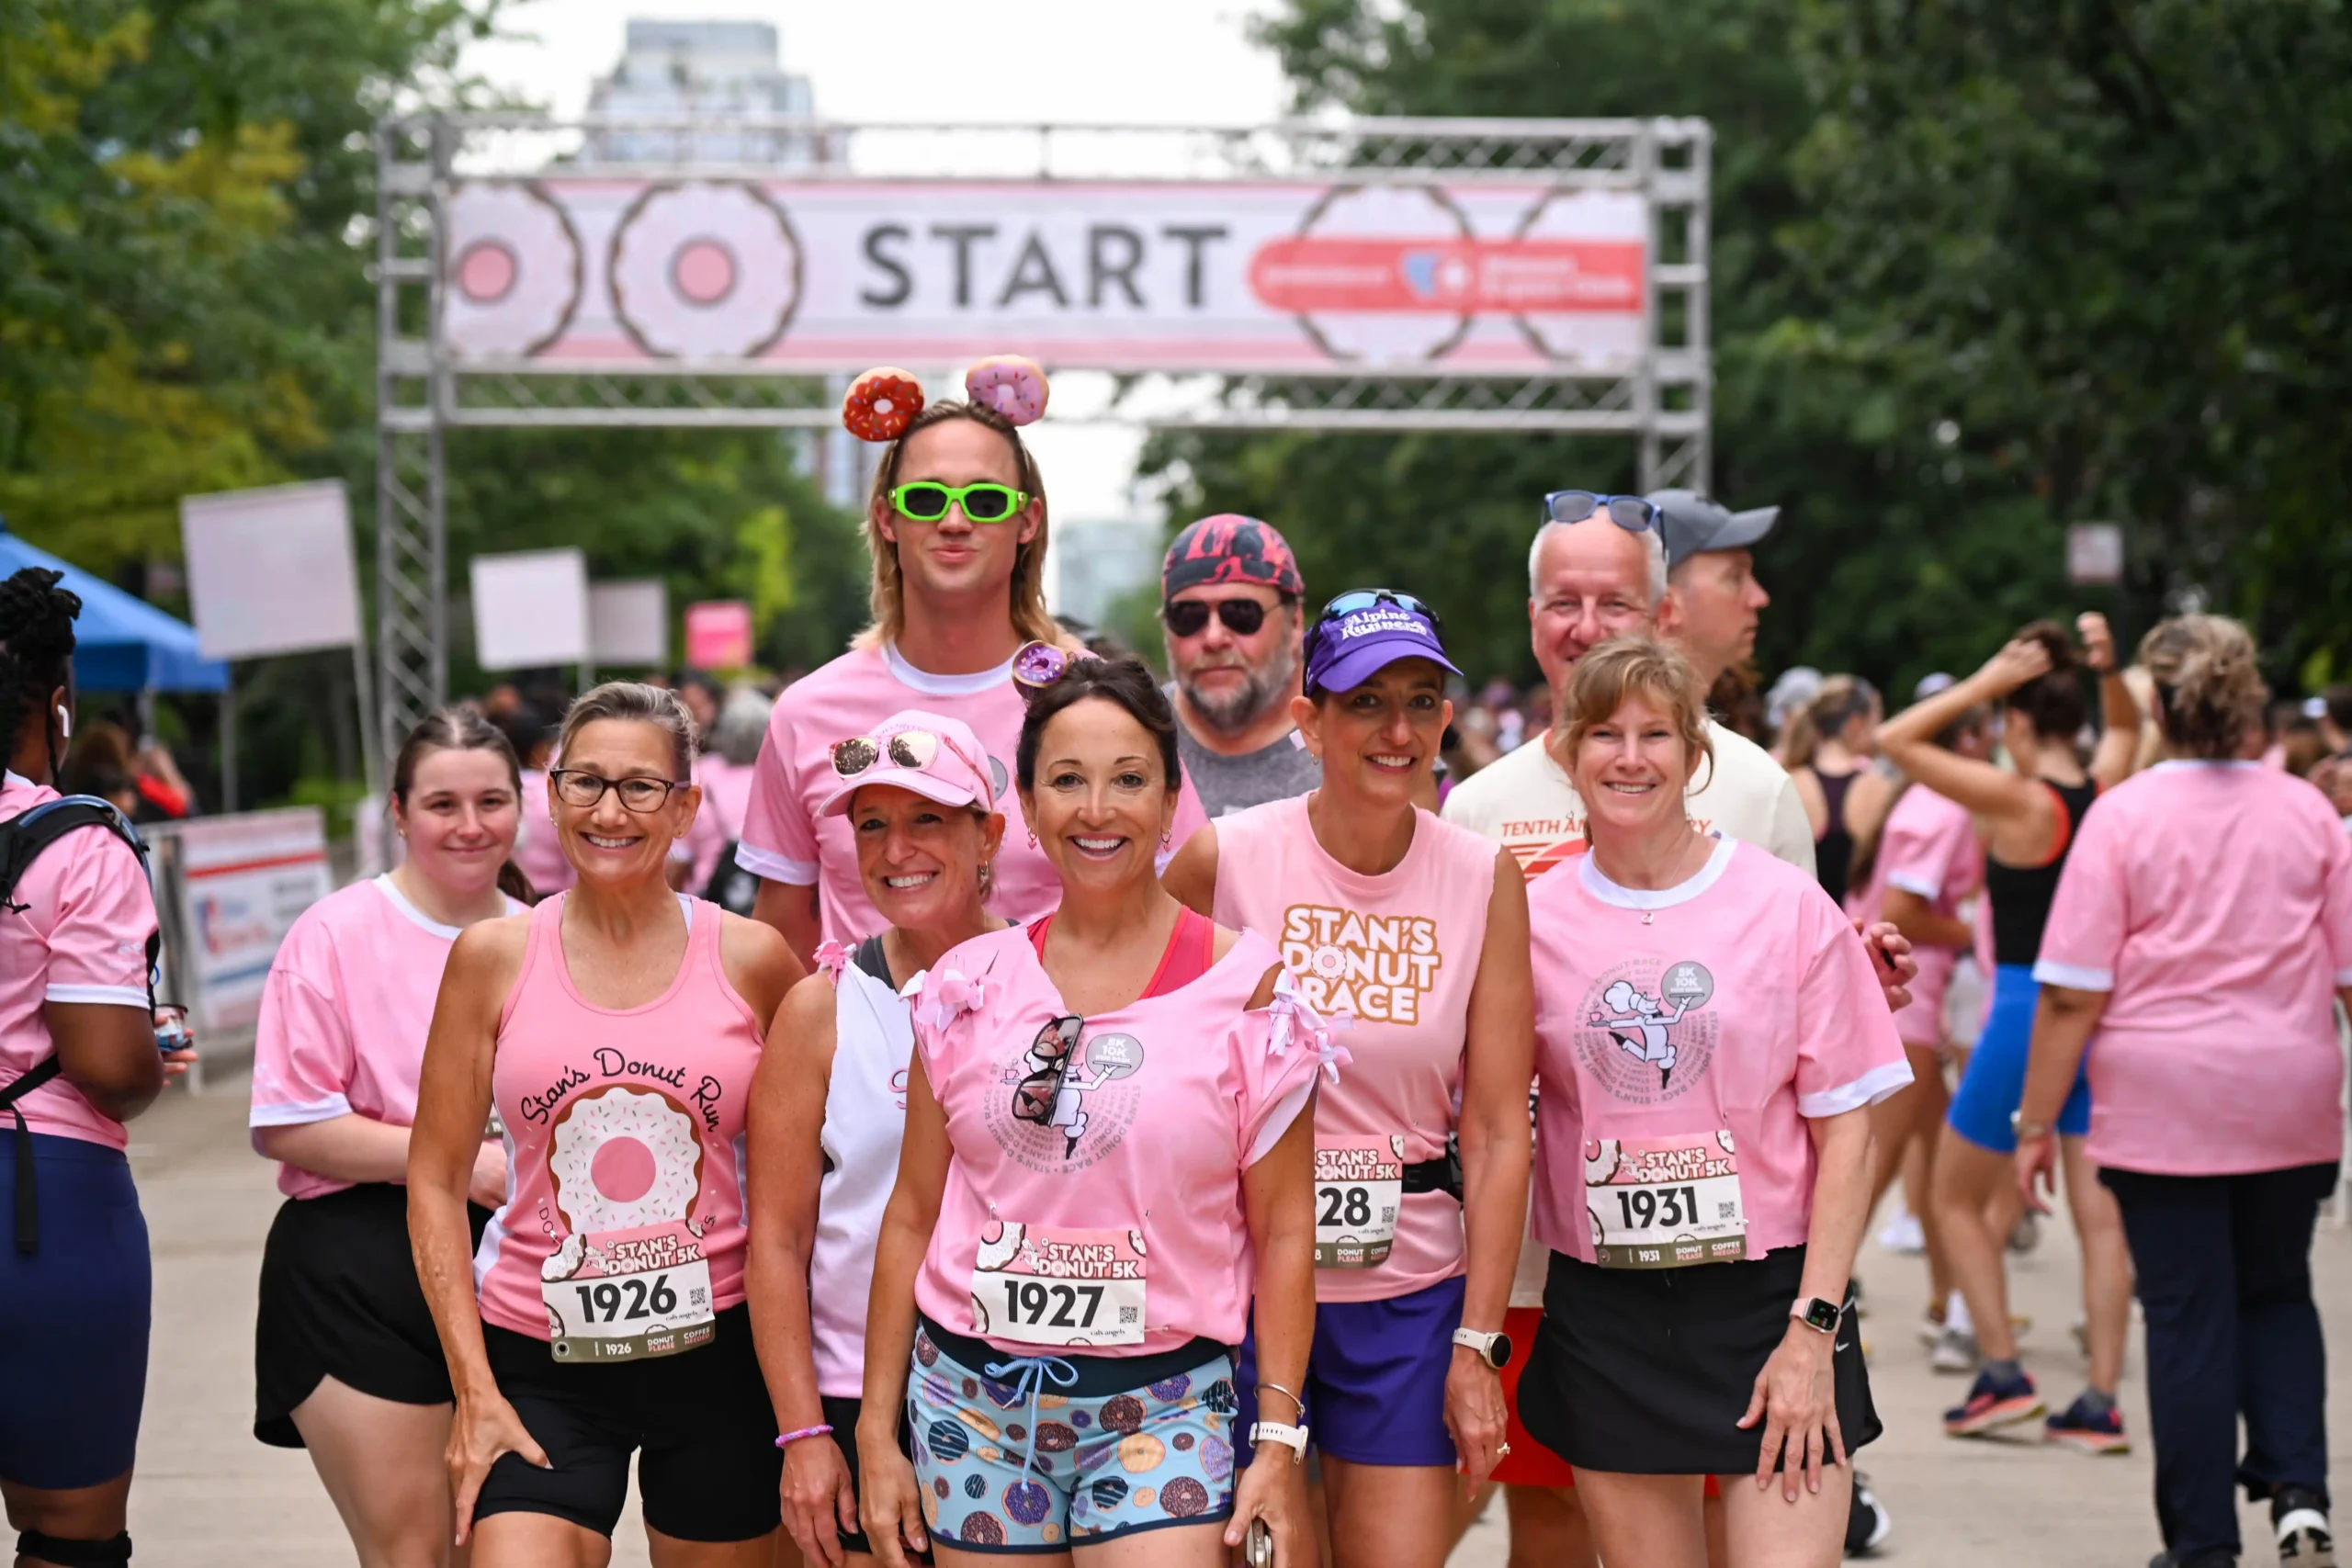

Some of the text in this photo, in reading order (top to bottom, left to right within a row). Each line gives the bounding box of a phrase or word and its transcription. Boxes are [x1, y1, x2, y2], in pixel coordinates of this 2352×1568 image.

[858, 223, 1229, 308] START
[1344, 608, 1411, 624] Alpine
[1340, 619, 1427, 640] Runners
[1501, 819, 1561, 838] TENTH
[1284, 905, 1435, 953] STAN'S
[1281, 940, 1440, 988] DONUT
[1678, 966, 1695, 977] 5K
[1675, 976, 1699, 987] 10K
[1301, 976, 1417, 1022] RACE
[1102, 1044, 1128, 1057] 10K
[1107, 1037, 1126, 1048] 5K
[521, 1047, 722, 1133] Stan's Donut Run
[984, 1088, 993, 1120] RACE
[988, 1122, 1015, 1157] DONUT
[1095, 1126, 1127, 1162] DONUT
[1016, 1154, 1050, 1173] STAN'S
[1061, 1158, 1093, 1173] RACE
[1317, 1149, 1378, 1165] STAN'S
[1645, 1147, 1706, 1168] STAN'S
[1375, 1164, 1396, 1179] 5K
[1639, 1158, 1729, 1182] DONUT 5K
[1315, 1187, 1371, 1226] 28
[1616, 1186, 1699, 1229] 1931
[615, 1235, 678, 1259] STAN'S
[1047, 1243, 1114, 1262] STAN'S
[1638, 1249, 1660, 1262] 1931
[1675, 1246, 1702, 1255] DONUT
[1711, 1241, 1741, 1251] COFFEE
[608, 1245, 701, 1275] DONUT 5K
[1337, 1255, 1364, 1263] PLEASE
[1677, 1252, 1703, 1261] PLEASE
[1038, 1258, 1138, 1279] DONUT 5K
[575, 1274, 677, 1324] 1926
[1004, 1280, 1105, 1327] 1927
[647, 1335, 674, 1347] DONUT
[684, 1326, 710, 1340] COFFEE
[684, 1333, 710, 1346] NEEDED
[605, 1342, 632, 1356] 1926
[648, 1343, 675, 1352] PLEASE
